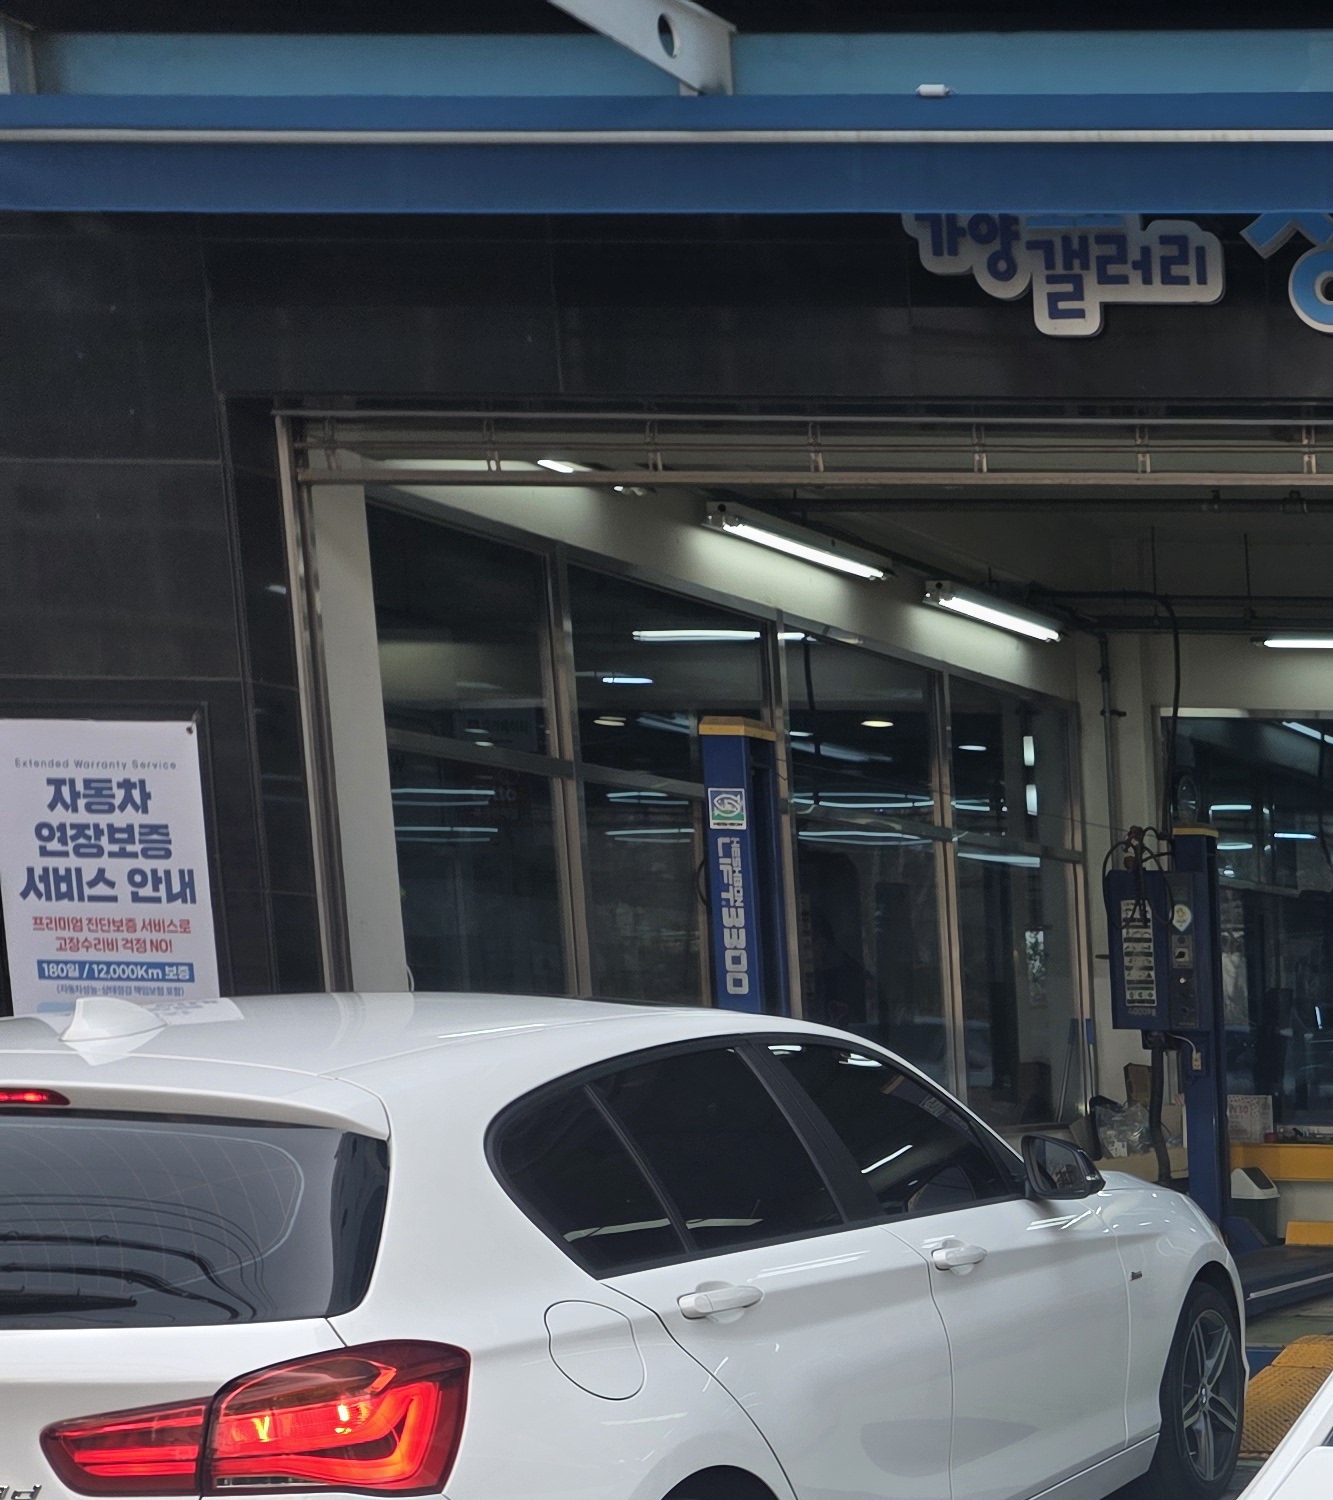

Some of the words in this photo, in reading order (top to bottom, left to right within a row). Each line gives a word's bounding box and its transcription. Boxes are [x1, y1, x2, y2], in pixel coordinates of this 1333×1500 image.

[1025, 234, 1207, 320] 갤러리
[15, 757, 69, 769] Extended
[74, 759, 127, 771] Warranty
[132, 760, 177, 770] Service
[46, 777, 151, 815] 자동차
[34, 821, 172, 860] 연장보증
[19, 866, 118, 903] 서비스
[127, 867, 197, 904] 안내
[730, 837, 744, 906] HESHBON
[32, 916, 83, 933] 프리미엄
[86, 917, 137, 933] 진단보증
[140, 918, 191, 934] 서비스로
[55, 936, 119, 953] 고장수리비
[122, 938, 147, 954] 걱정
[150, 939, 172, 953] NO!
[42, 962, 79, 978] 180일
[92, 963, 162, 980] 12,000Km
[165, 965, 190, 980] 보증
